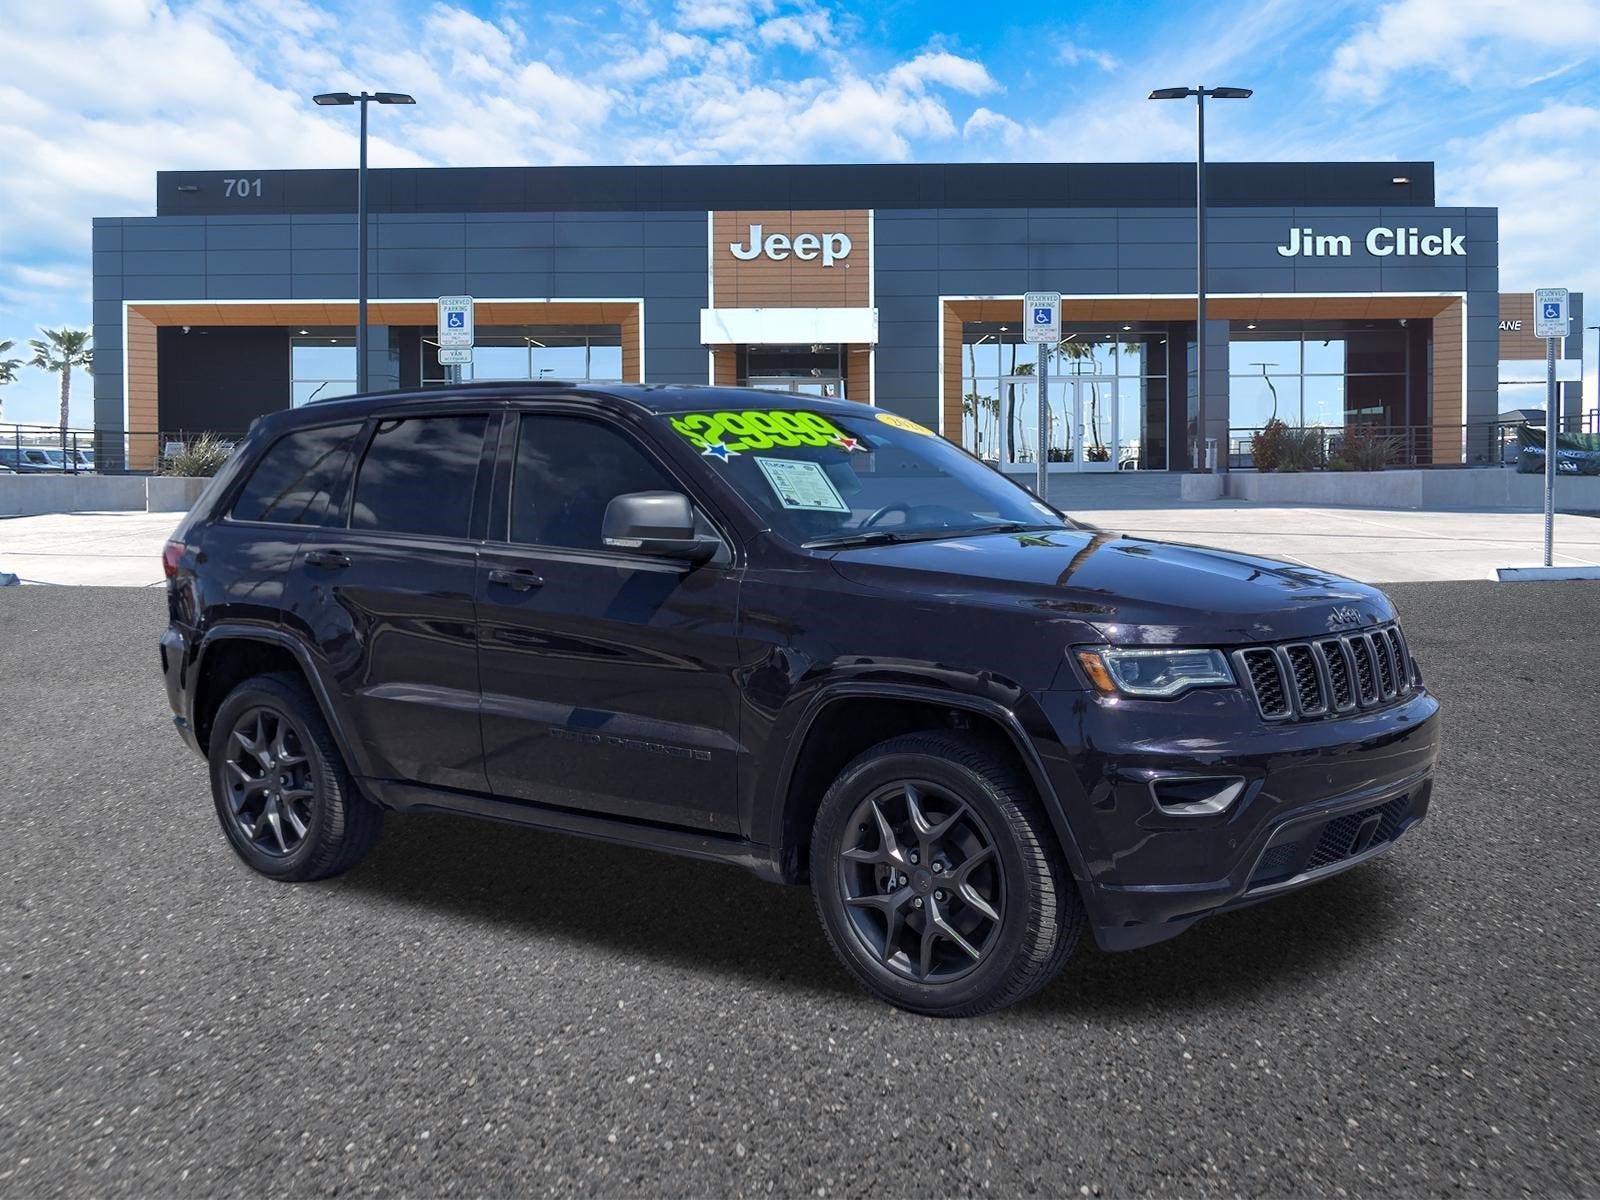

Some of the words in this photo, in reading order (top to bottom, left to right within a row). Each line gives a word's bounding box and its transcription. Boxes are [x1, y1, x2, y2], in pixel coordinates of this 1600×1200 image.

[223, 178, 262, 197] 701
[730, 224, 852, 267] Jeep
[1277, 228, 1351, 257] Jim
[1366, 227, 1467, 257] Click
[1328, 605, 1361, 626] Jeep
